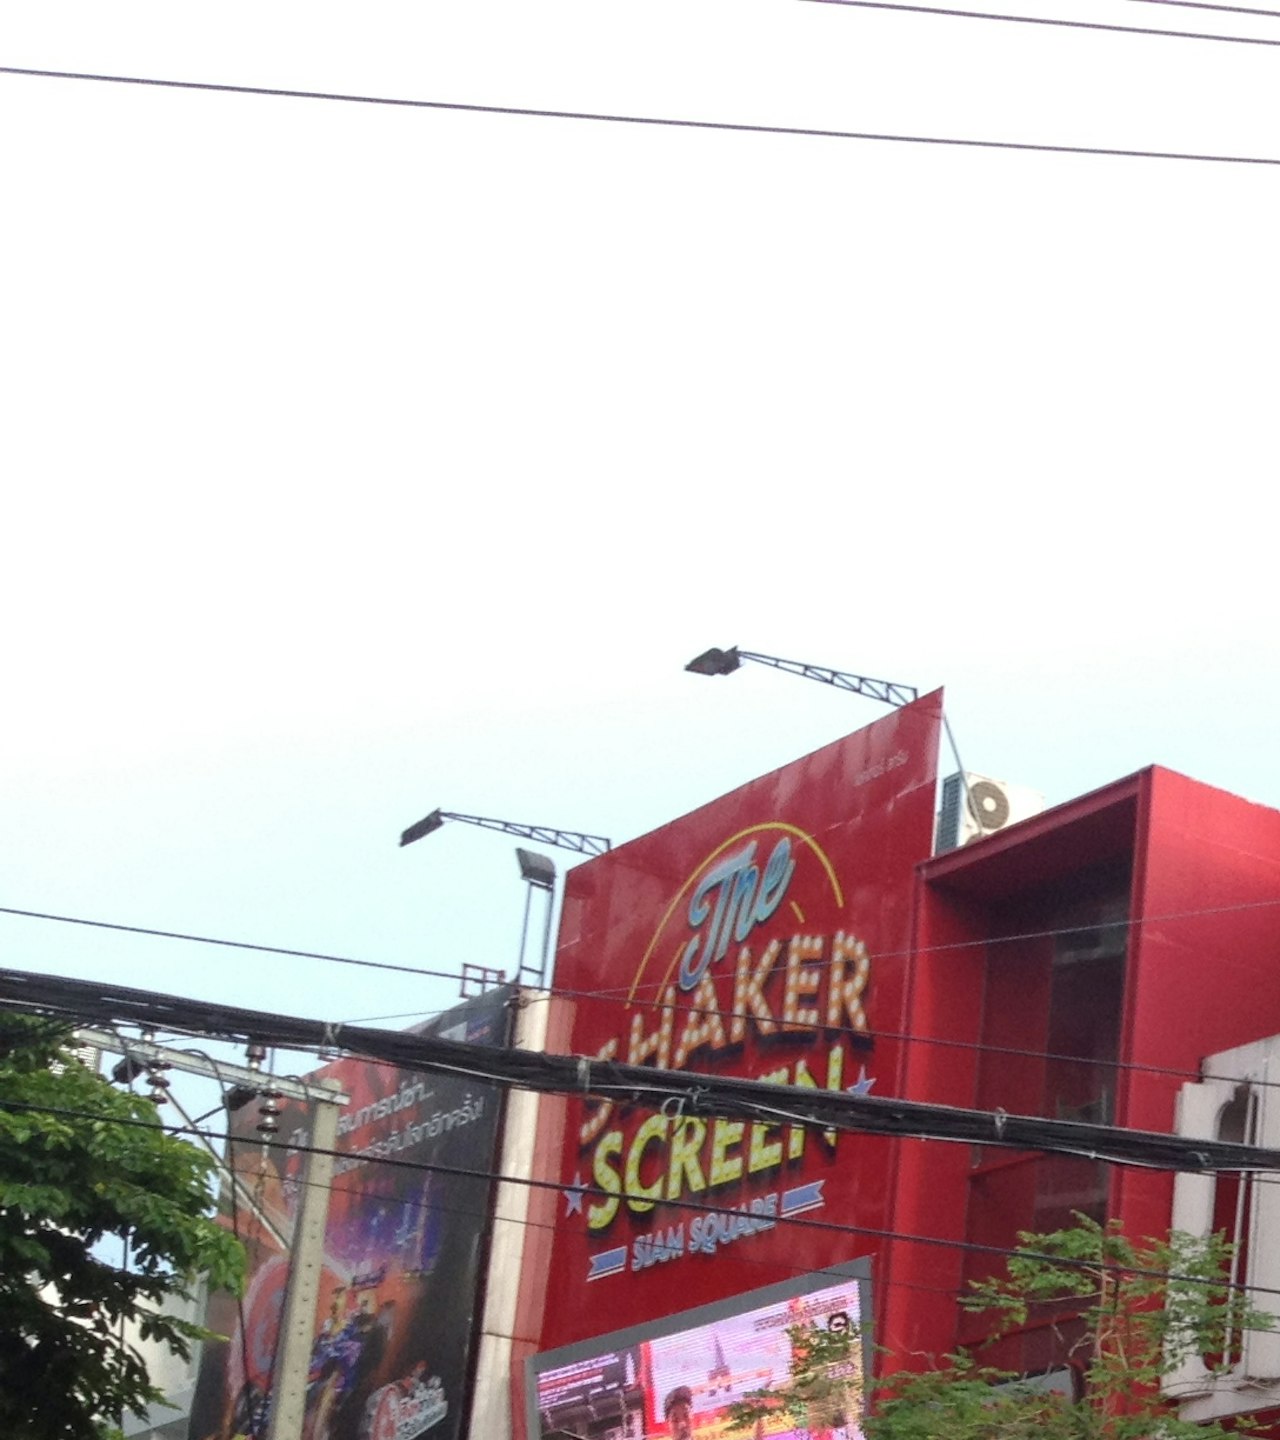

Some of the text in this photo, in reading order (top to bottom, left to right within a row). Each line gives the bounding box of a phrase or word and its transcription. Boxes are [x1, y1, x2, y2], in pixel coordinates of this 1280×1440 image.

[679, 837, 796, 991] The
[588, 1044, 844, 1229] SCREEN
[631, 1193, 778, 1272] SIAM SQUARE
